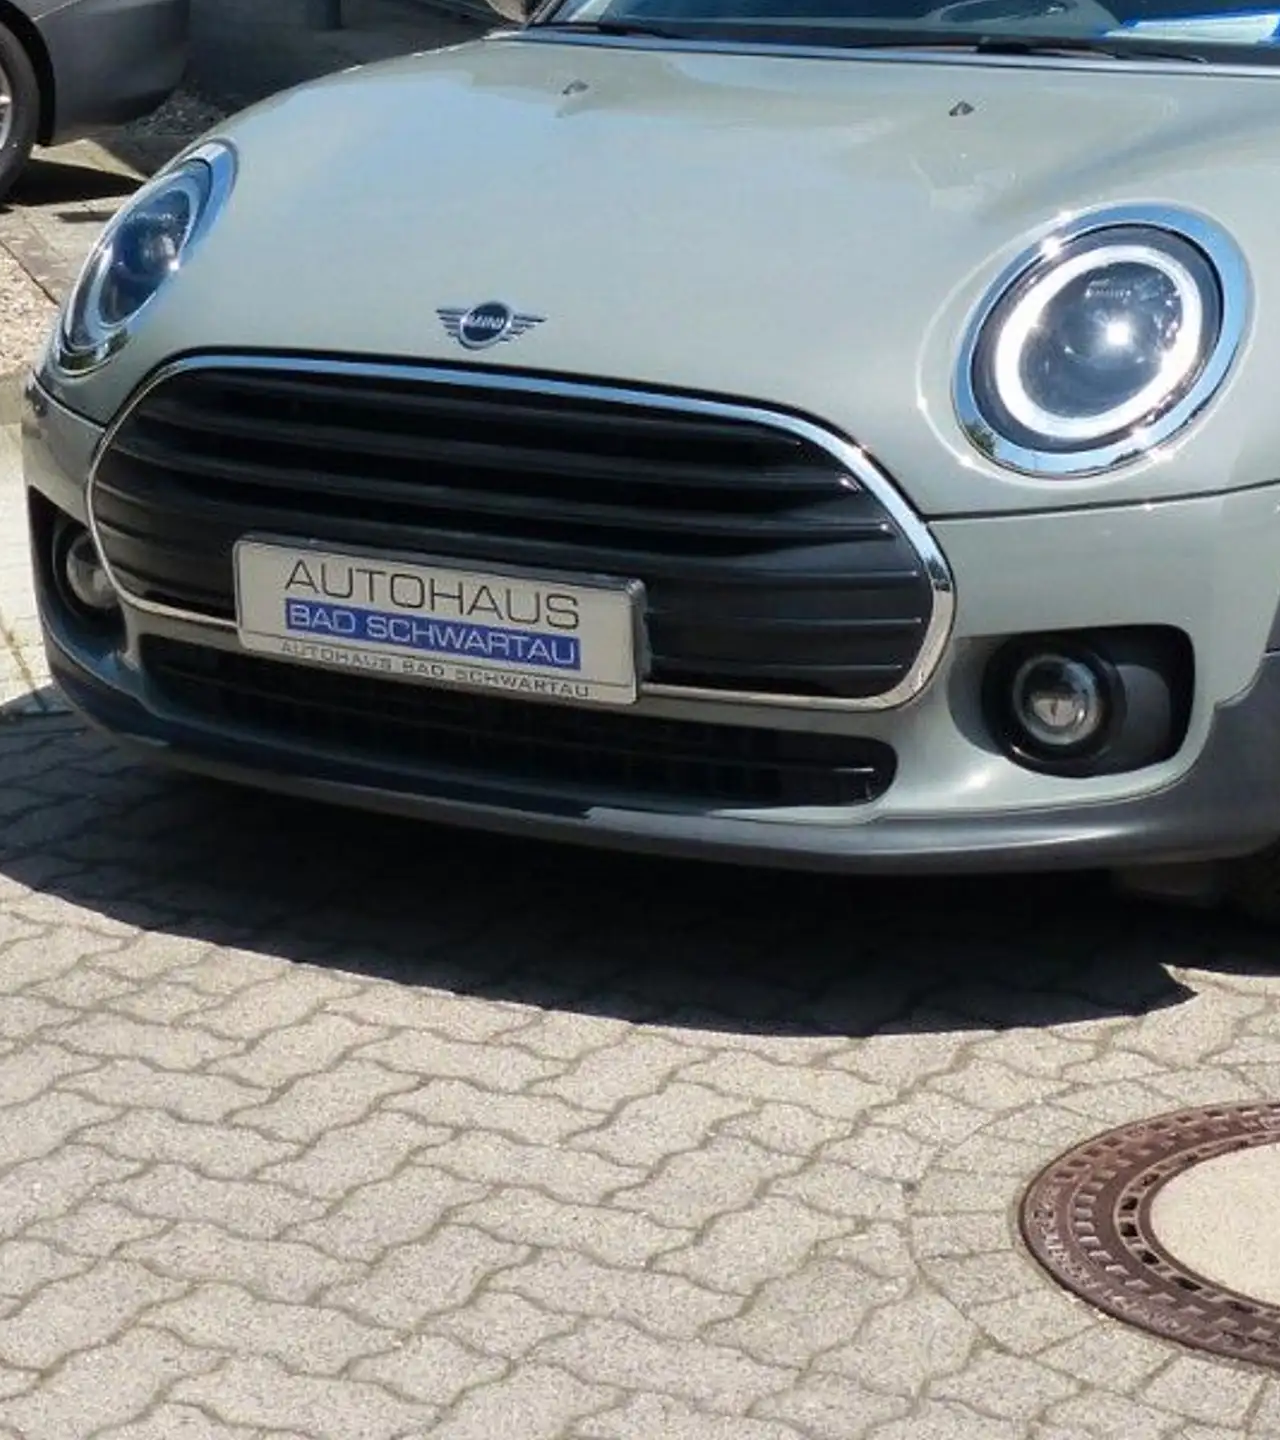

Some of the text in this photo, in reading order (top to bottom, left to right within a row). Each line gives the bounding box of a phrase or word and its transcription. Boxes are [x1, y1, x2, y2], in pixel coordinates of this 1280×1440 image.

[285, 560, 580, 629] AUTOHAUS
[289, 604, 576, 664] BAD SCHWARTAU
[281, 643, 590, 698] AUTOHAUS BAD SCHWARTAU
